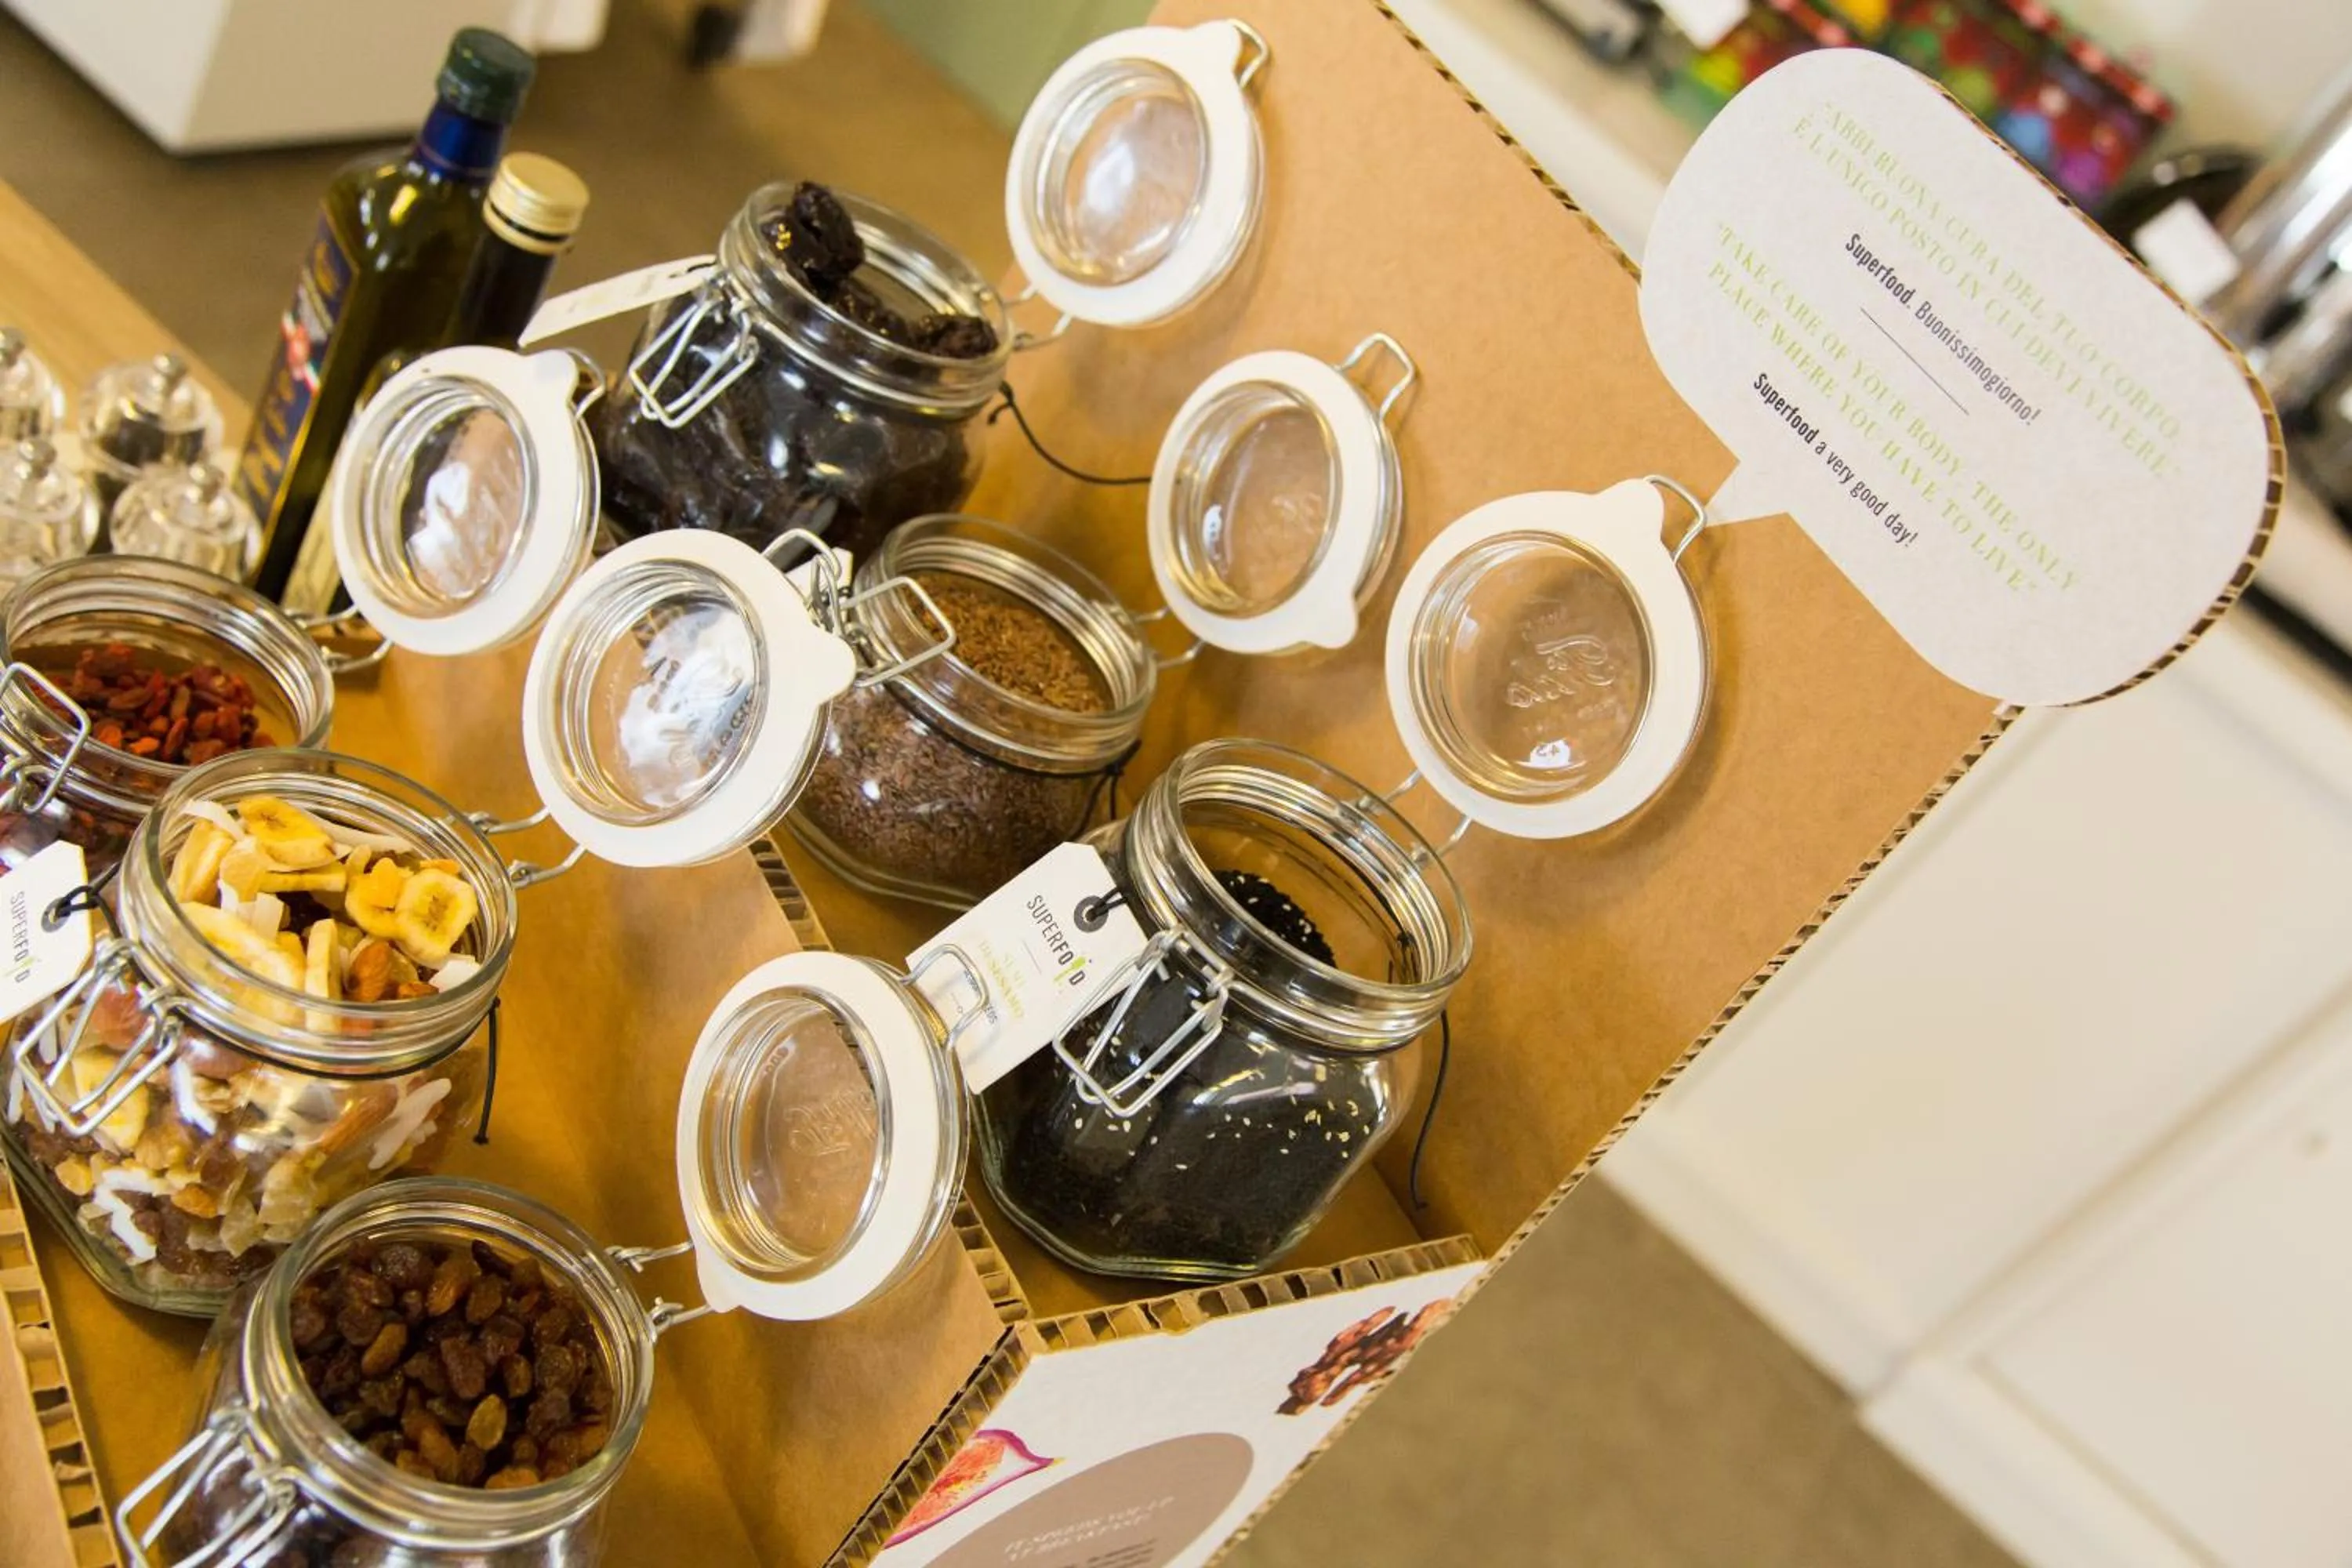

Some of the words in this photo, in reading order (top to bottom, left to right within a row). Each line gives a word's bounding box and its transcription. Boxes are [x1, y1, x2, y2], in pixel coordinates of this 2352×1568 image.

[1846, 234, 1916, 309] Superfood.
[1915, 301, 2041, 425] Buonissimogiorno!
[1888, 207, 1955, 274] POSTO
[1957, 272, 1984, 299] IN
[2002, 270, 2045, 319] DEL
[2052, 313, 2099, 361] TUO
[1708, 260, 1769, 328] PLACE
[1769, 322, 1838, 399] WHERE
[1839, 394, 1878, 440] YOU
[1880, 439, 1939, 503] HAVE
[1940, 498, 1973, 534] TO
[1753, 372, 1820, 445] Superfood
[1815, 441, 1827, 456] a
[1827, 452, 1855, 485] very
[1849, 481, 1889, 517] good
[1884, 514, 1918, 547] day!
[1771, 279, 1823, 336] CARE
[1822, 332, 1850, 361] OF
[1852, 358, 1908, 421] YOUR
[1972, 481, 2018, 533] THE
[2016, 530, 2079, 591] ONLY
